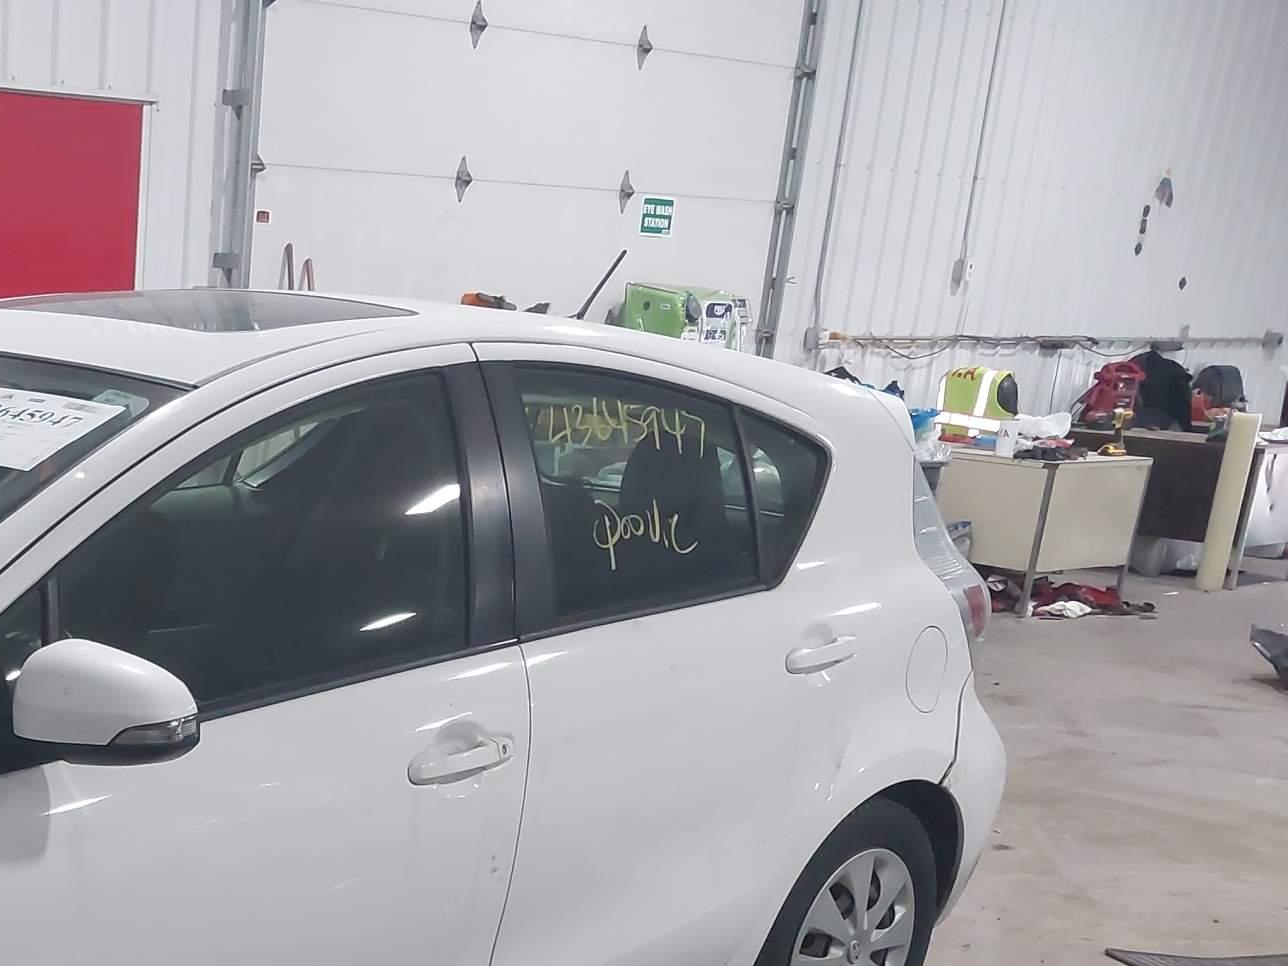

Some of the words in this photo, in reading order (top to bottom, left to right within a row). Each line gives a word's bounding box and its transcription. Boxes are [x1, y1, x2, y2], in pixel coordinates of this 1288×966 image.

[643, 204, 655, 215] EYE
[655, 205, 673, 216] WASH
[643, 217, 669, 228] STATION
[548, 396, 705, 459] 43645947
